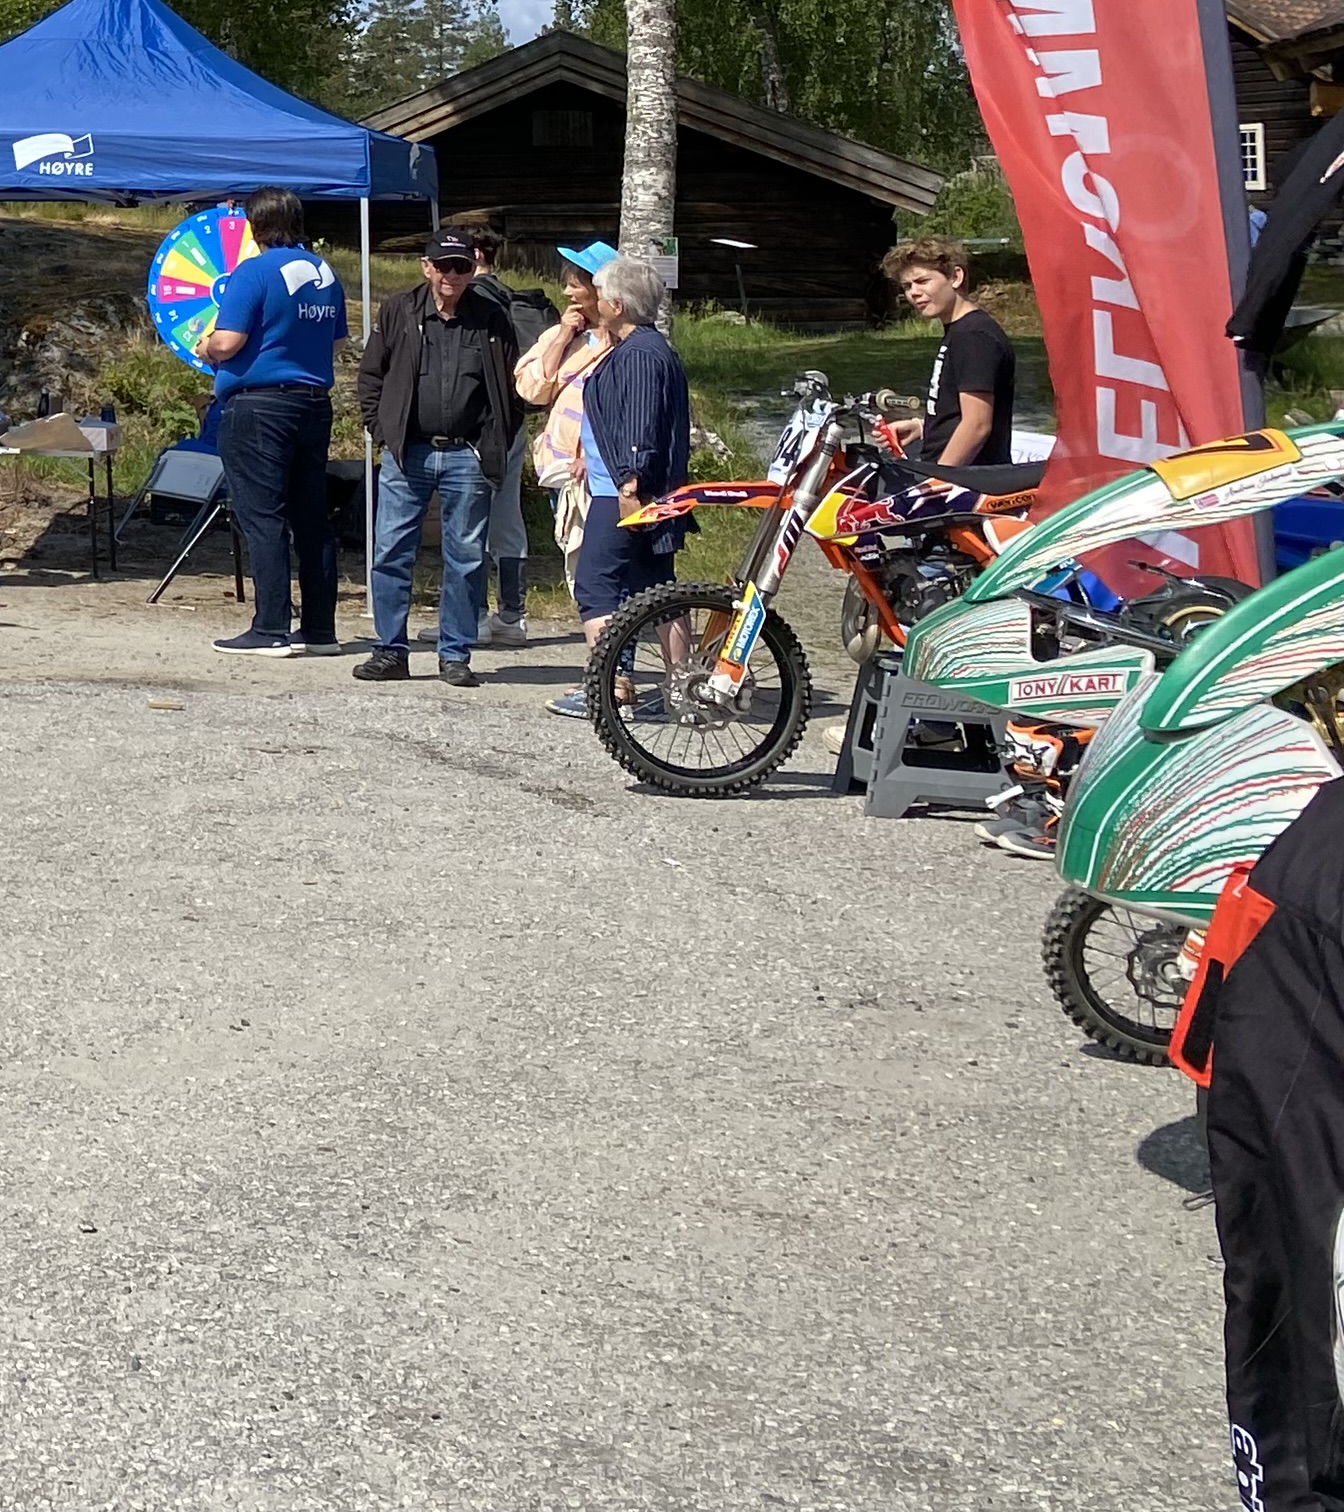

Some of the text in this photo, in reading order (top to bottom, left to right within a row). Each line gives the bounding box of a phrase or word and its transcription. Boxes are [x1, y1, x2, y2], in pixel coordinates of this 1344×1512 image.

[38, 161, 94, 177] HØYRE
[298, 302, 337, 323] Høyre
[1016, 674, 1121, 698] TONY KART
